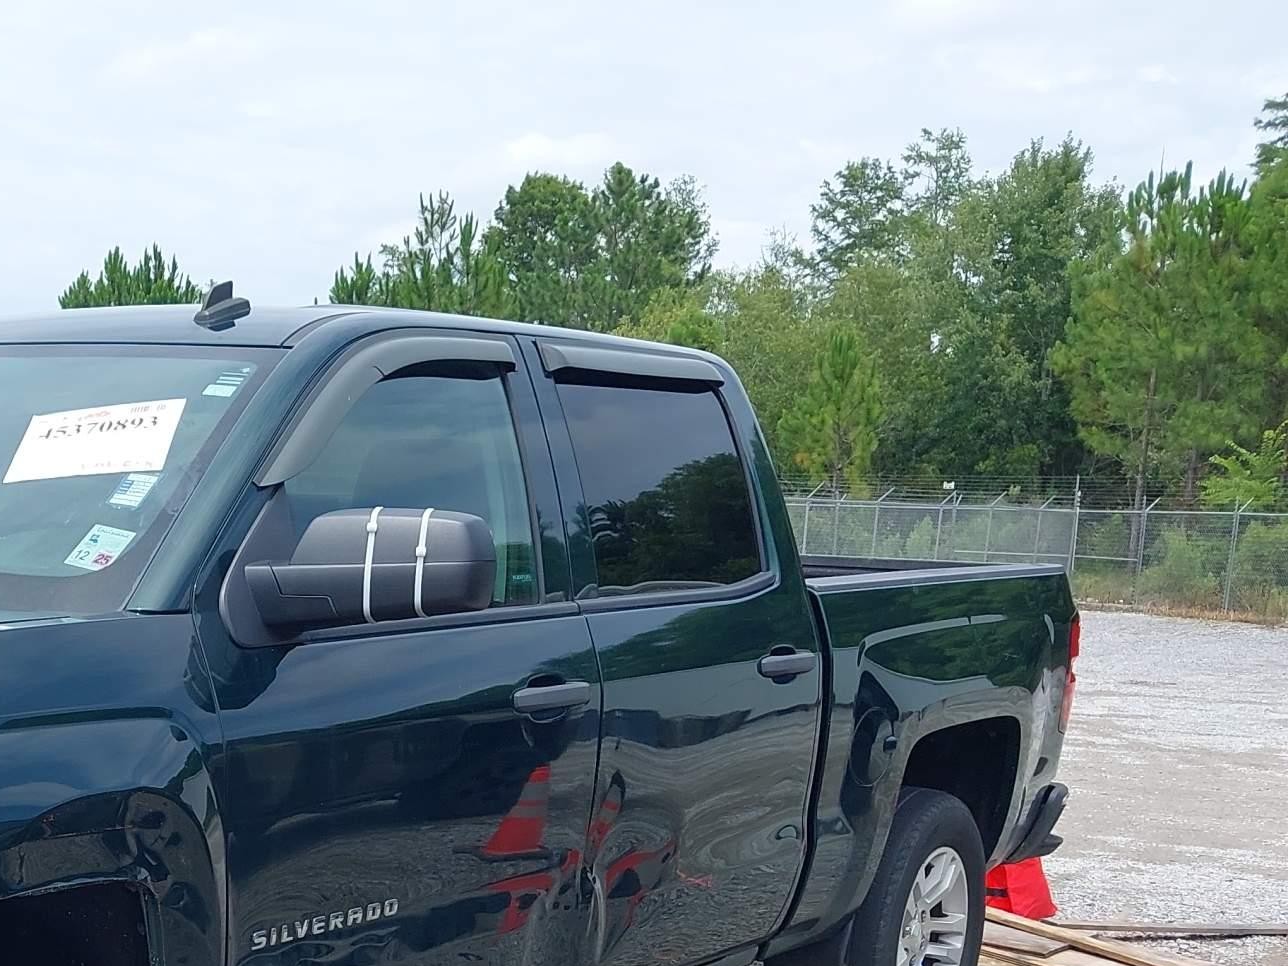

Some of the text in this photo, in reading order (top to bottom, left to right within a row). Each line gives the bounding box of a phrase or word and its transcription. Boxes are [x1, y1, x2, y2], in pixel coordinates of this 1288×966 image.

[38, 415, 159, 440] 45370893
[72, 549, 90, 561] 12
[93, 553, 112, 566] 25
[251, 898, 399, 950] SILVERADO
